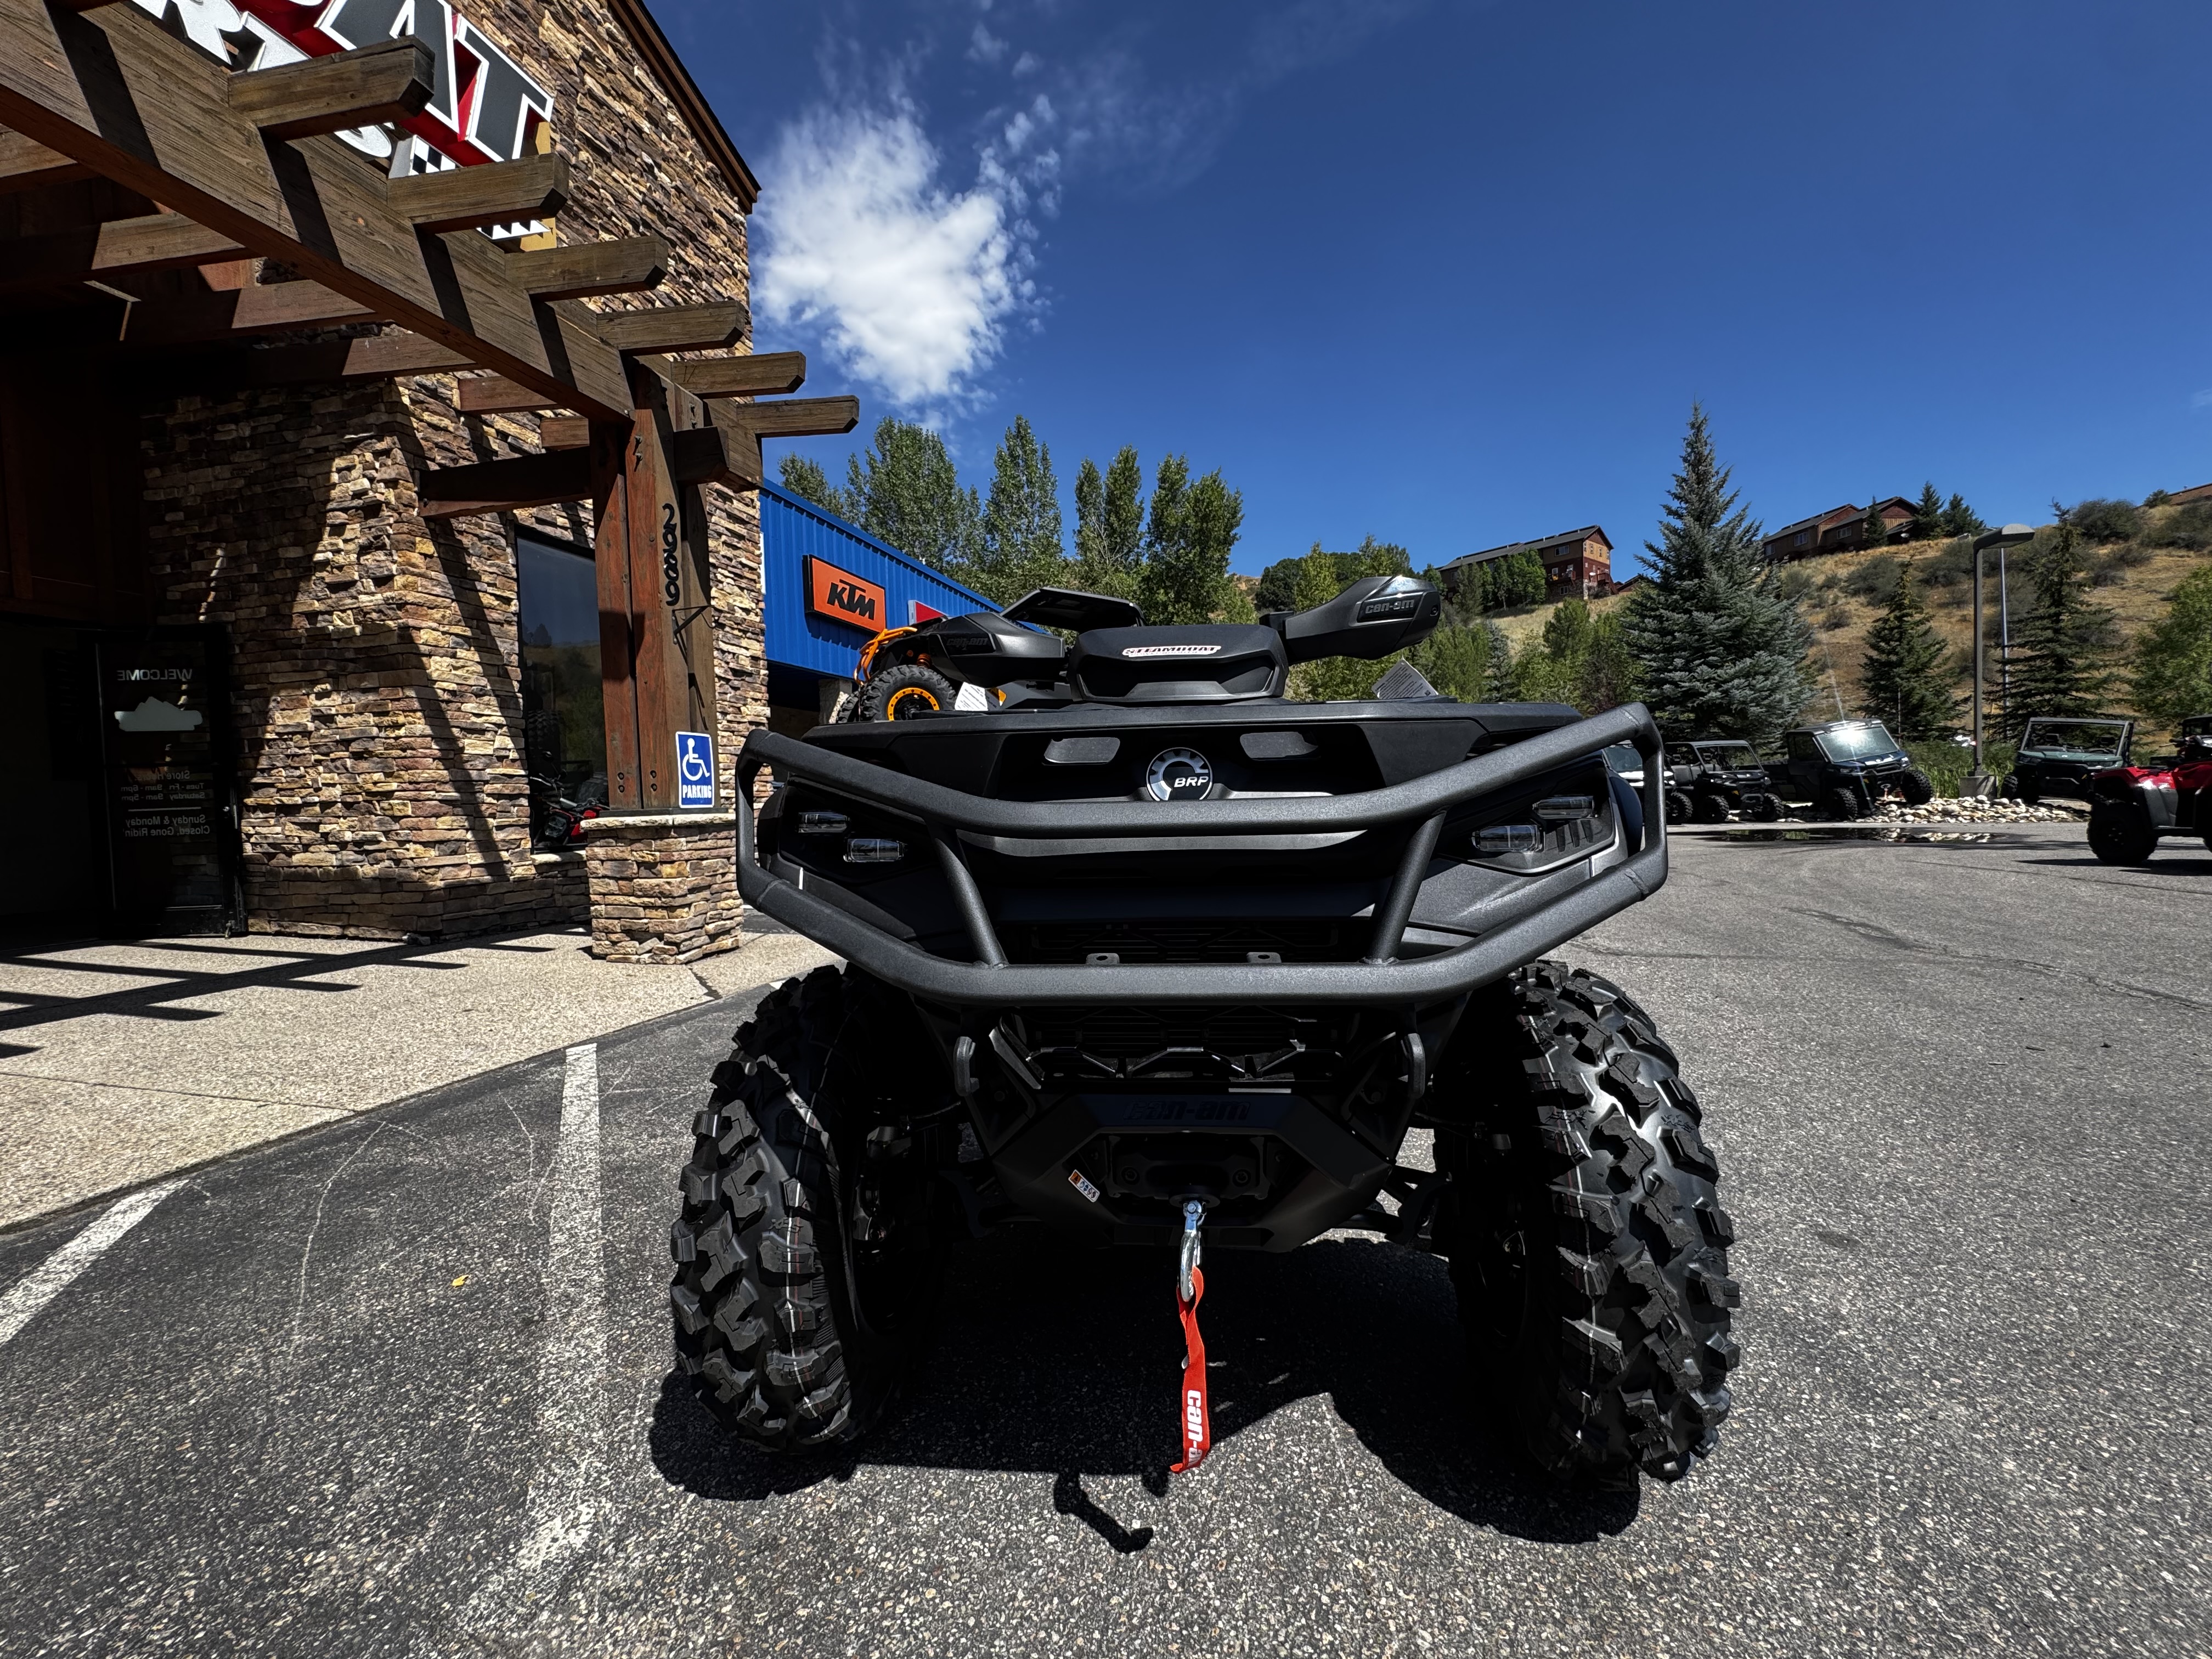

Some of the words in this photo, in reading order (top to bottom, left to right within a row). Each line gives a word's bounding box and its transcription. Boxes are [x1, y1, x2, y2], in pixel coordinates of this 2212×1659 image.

[662, 503, 680, 606] 2989
[827, 579, 875, 620] KTM
[1365, 600, 1414, 613] can-am
[1174, 776, 1209, 788] BRP
[682, 785, 712, 798] PARKING
[1122, 1101, 1249, 1120] can-am
